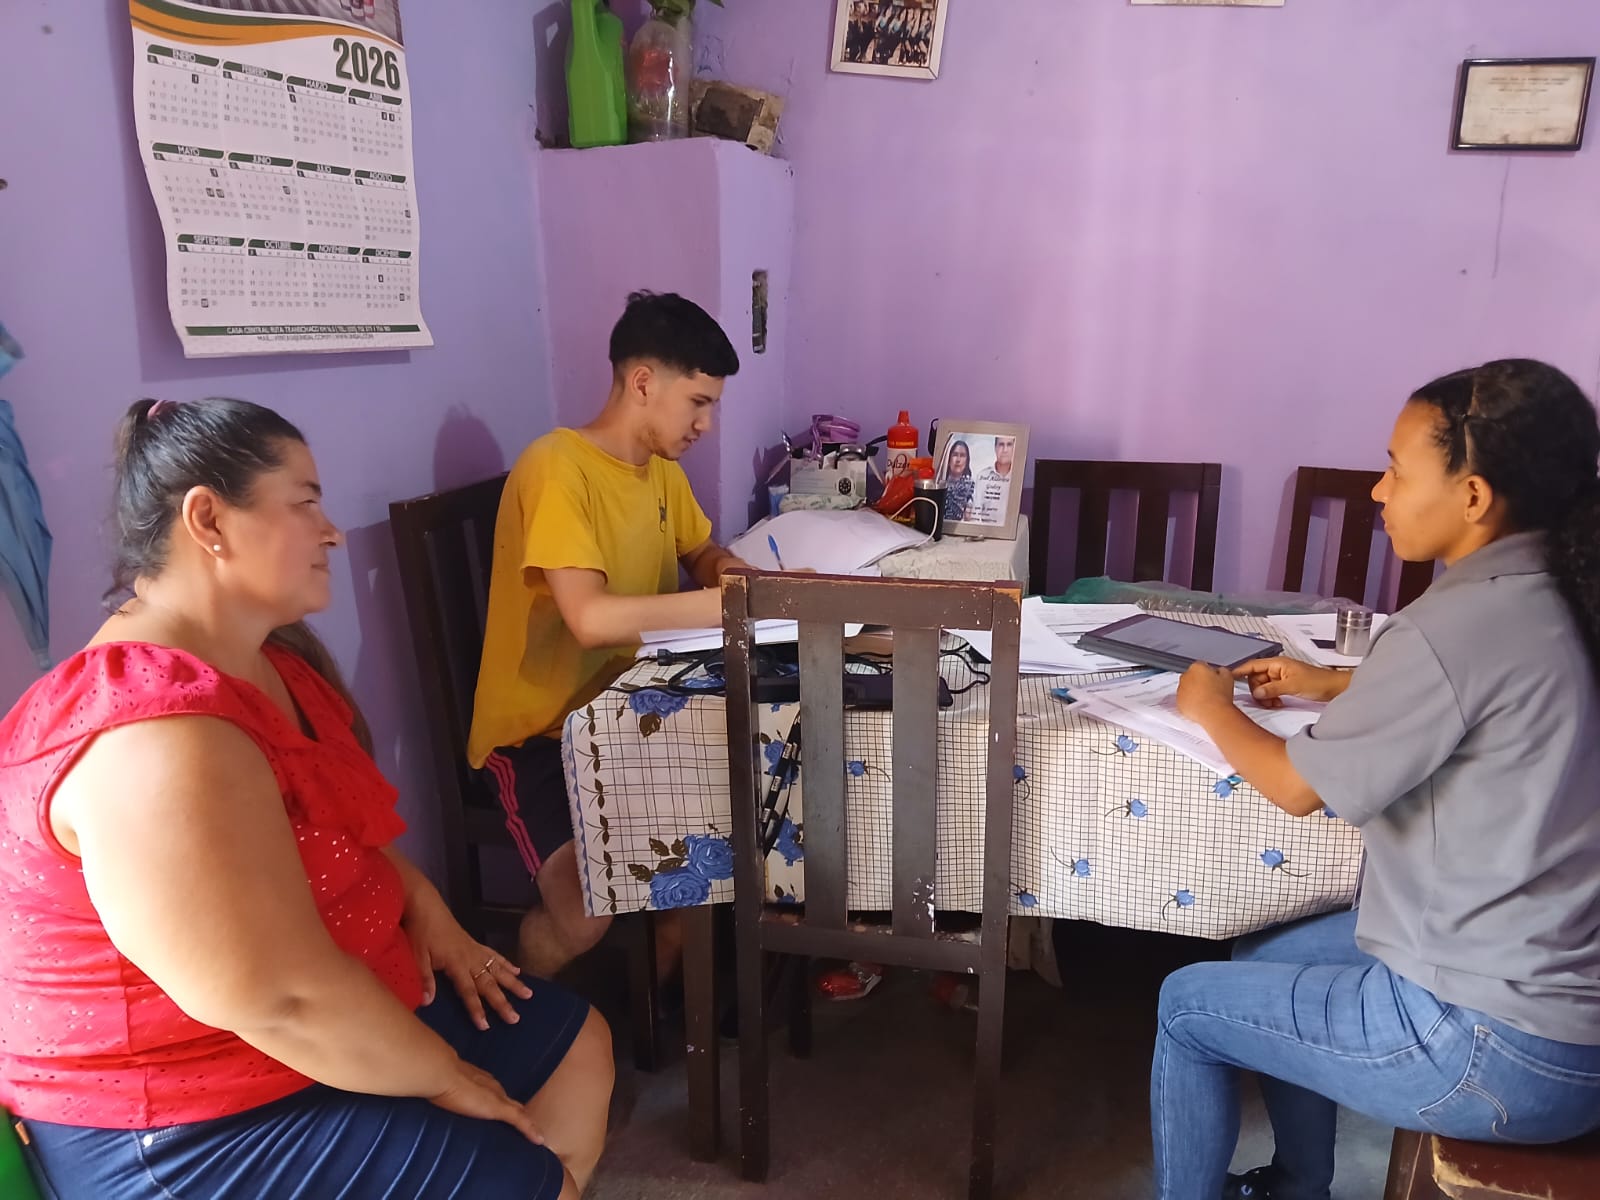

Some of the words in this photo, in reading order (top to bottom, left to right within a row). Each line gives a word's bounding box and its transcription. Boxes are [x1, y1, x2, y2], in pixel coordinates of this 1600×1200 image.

[333, 38, 401, 91] 2026
[305, 79, 329, 92] MARZO
[178, 145, 199, 157] MAYO
